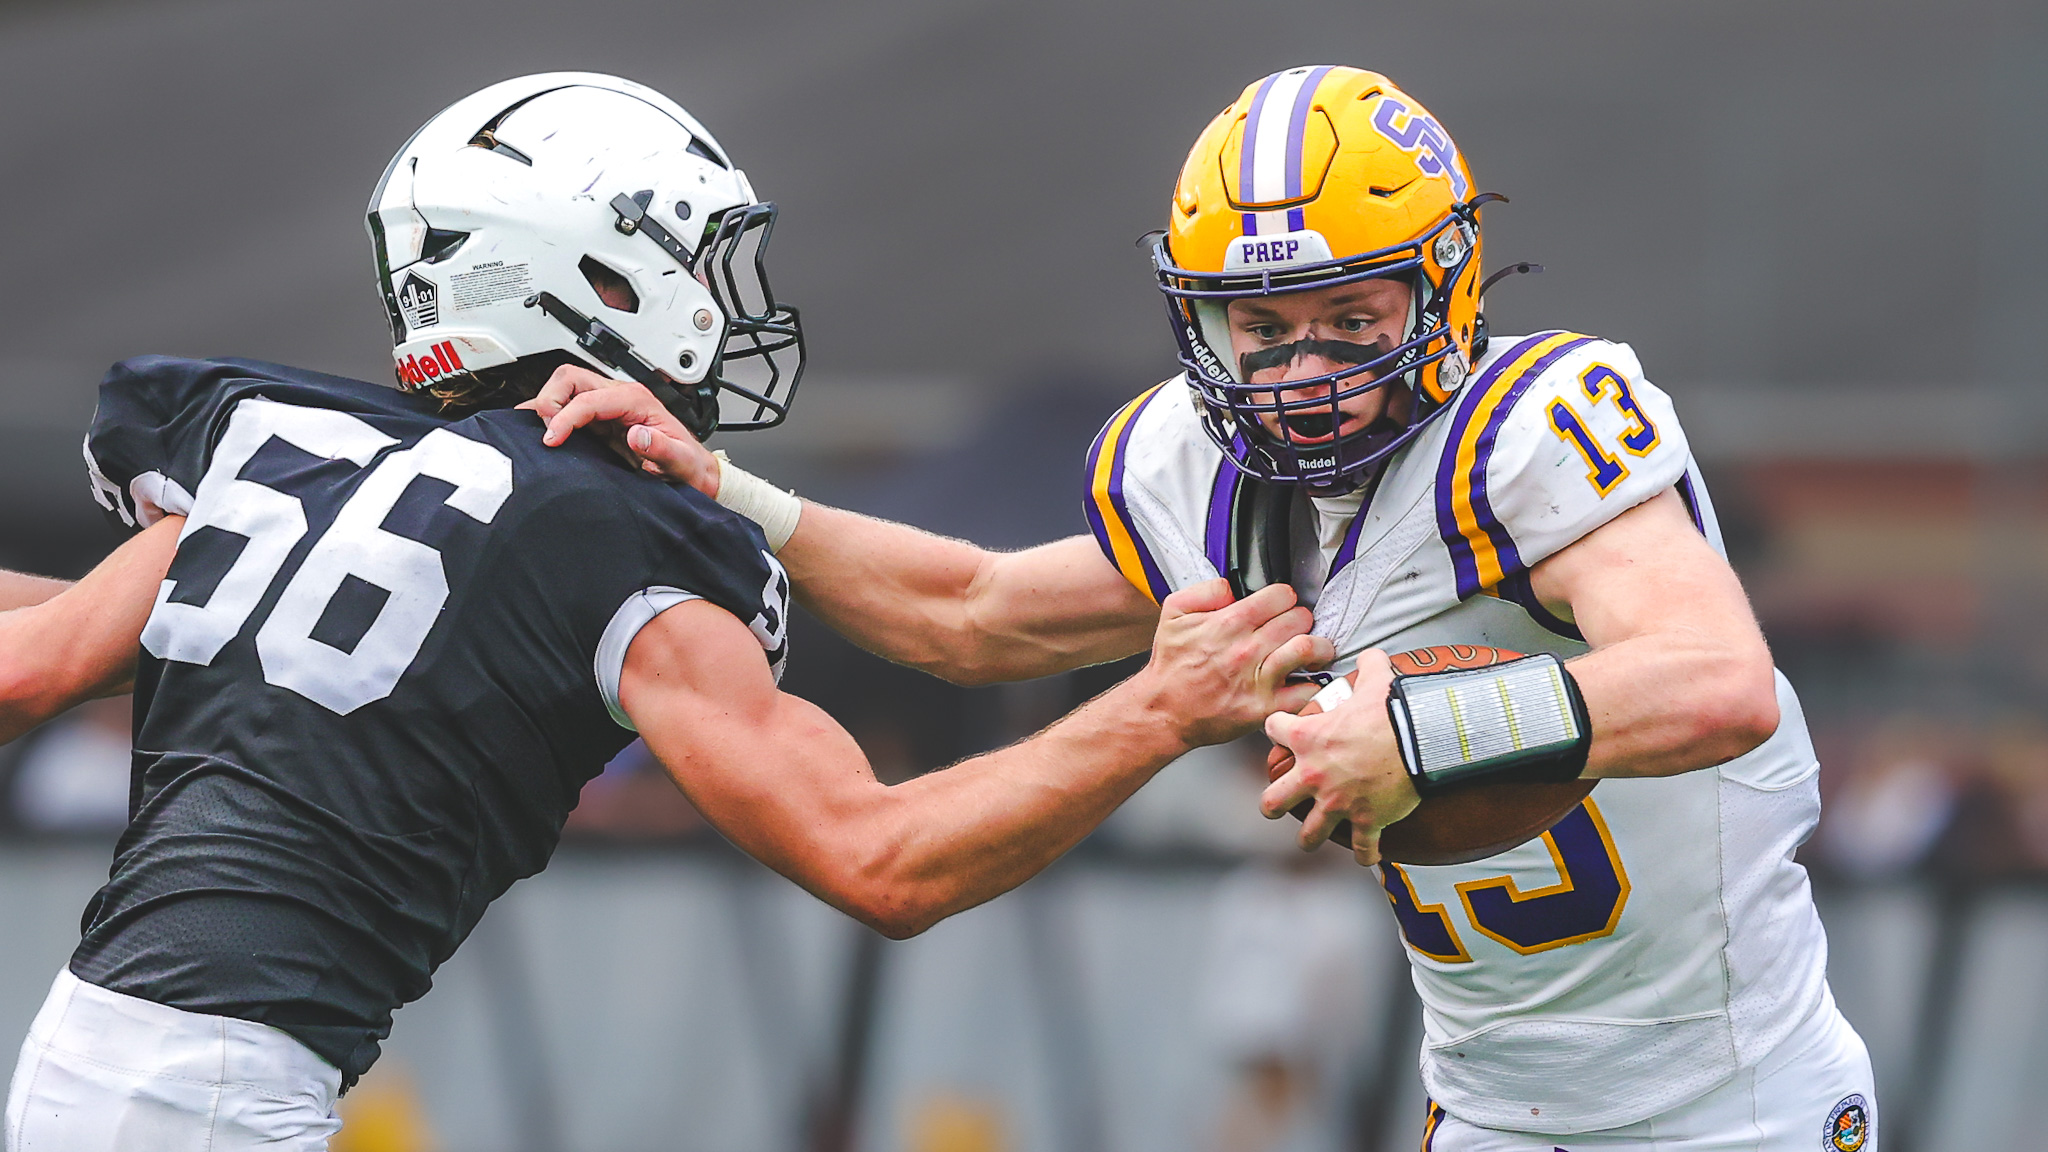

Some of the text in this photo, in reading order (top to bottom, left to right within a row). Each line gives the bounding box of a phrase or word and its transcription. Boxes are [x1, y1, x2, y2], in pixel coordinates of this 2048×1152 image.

[1242, 239, 1299, 264] PREP
[472, 260, 504, 271] WARNING
[1544, 361, 1661, 500] 13
[1297, 455, 1336, 471] Riddel
[140, 396, 513, 717] 56
